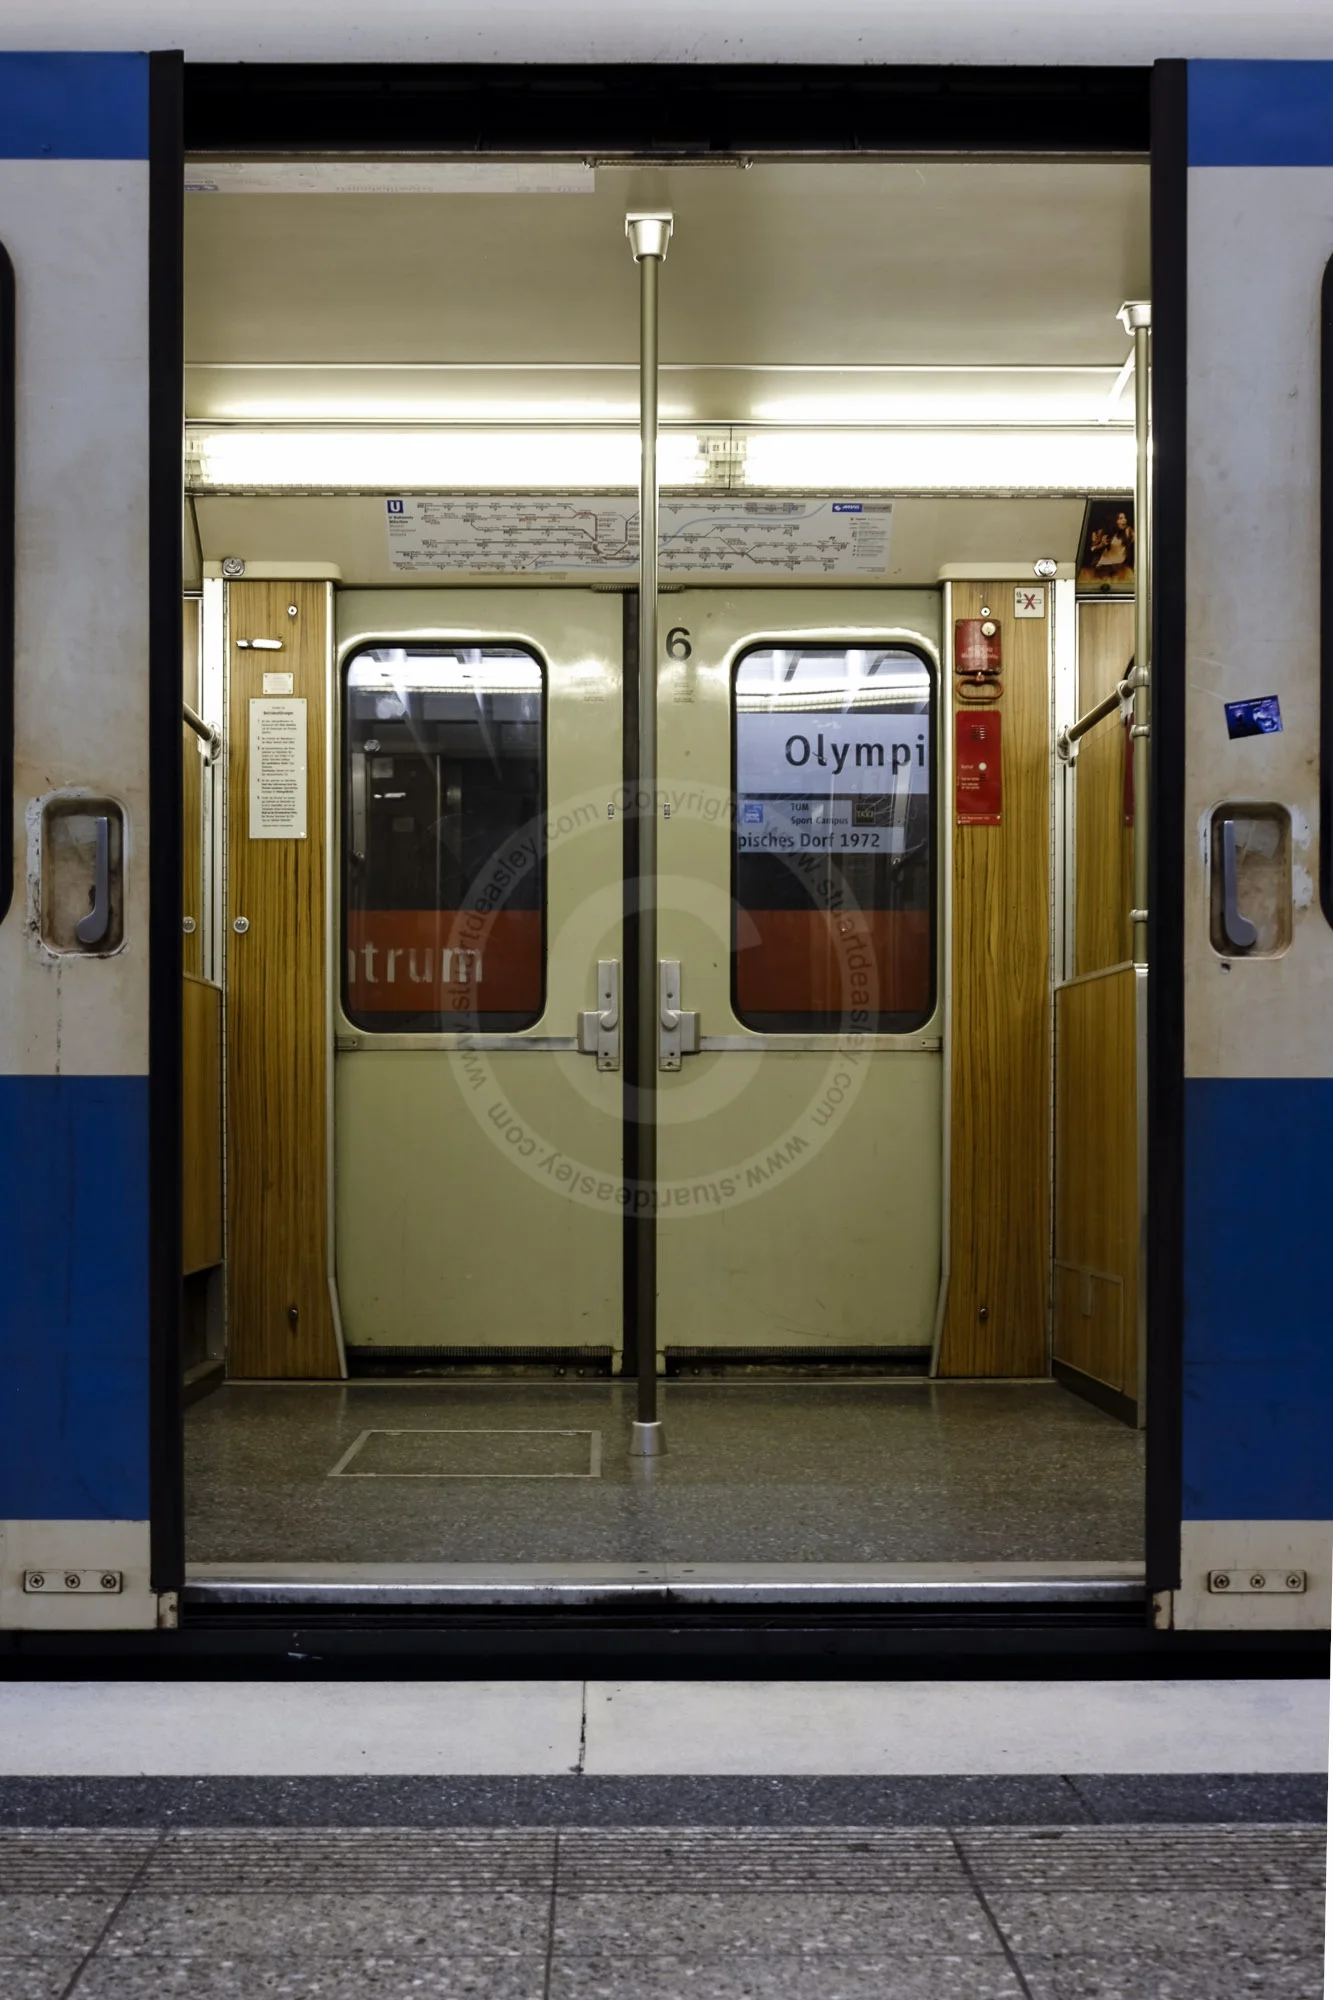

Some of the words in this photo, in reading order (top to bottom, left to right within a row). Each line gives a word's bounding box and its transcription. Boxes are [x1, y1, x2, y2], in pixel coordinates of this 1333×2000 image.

[665, 626, 692, 661] 6
[785, 734, 925, 775] Olympi
[790, 816, 813, 826] Sport
[738, 832, 794, 850] pisches
[800, 832, 834, 847] Dorf
[840, 834, 880, 848] 1972
